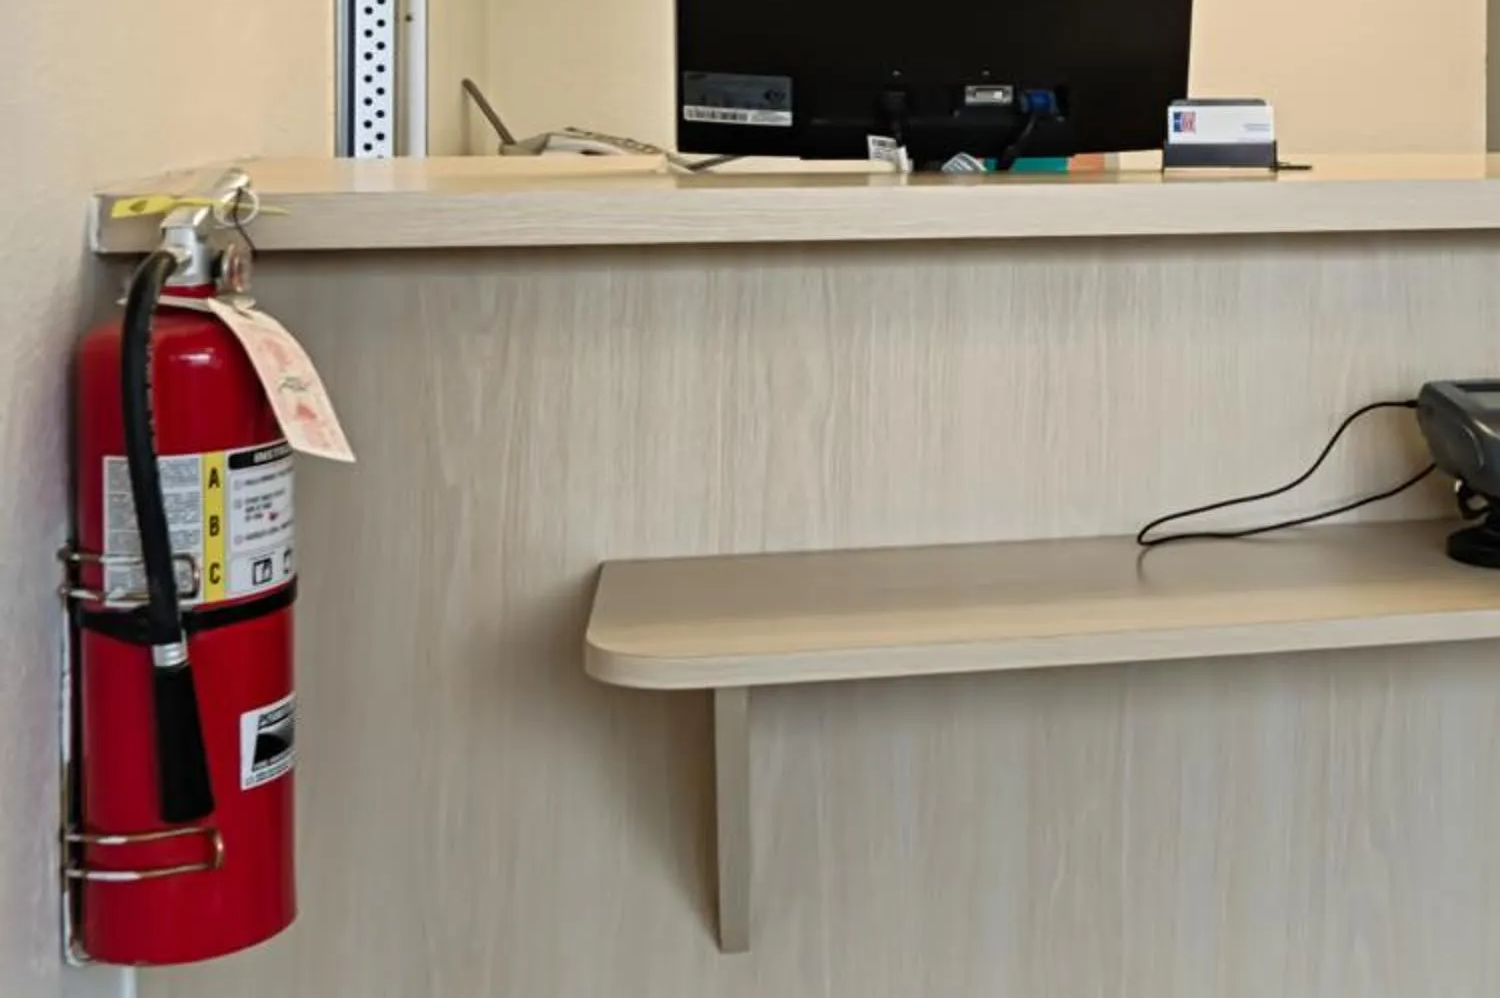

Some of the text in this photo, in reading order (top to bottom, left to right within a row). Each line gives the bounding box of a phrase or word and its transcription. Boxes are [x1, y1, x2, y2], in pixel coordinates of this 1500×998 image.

[208, 467, 220, 489] A
[209, 515, 220, 537] B
[209, 562, 221, 585] C
